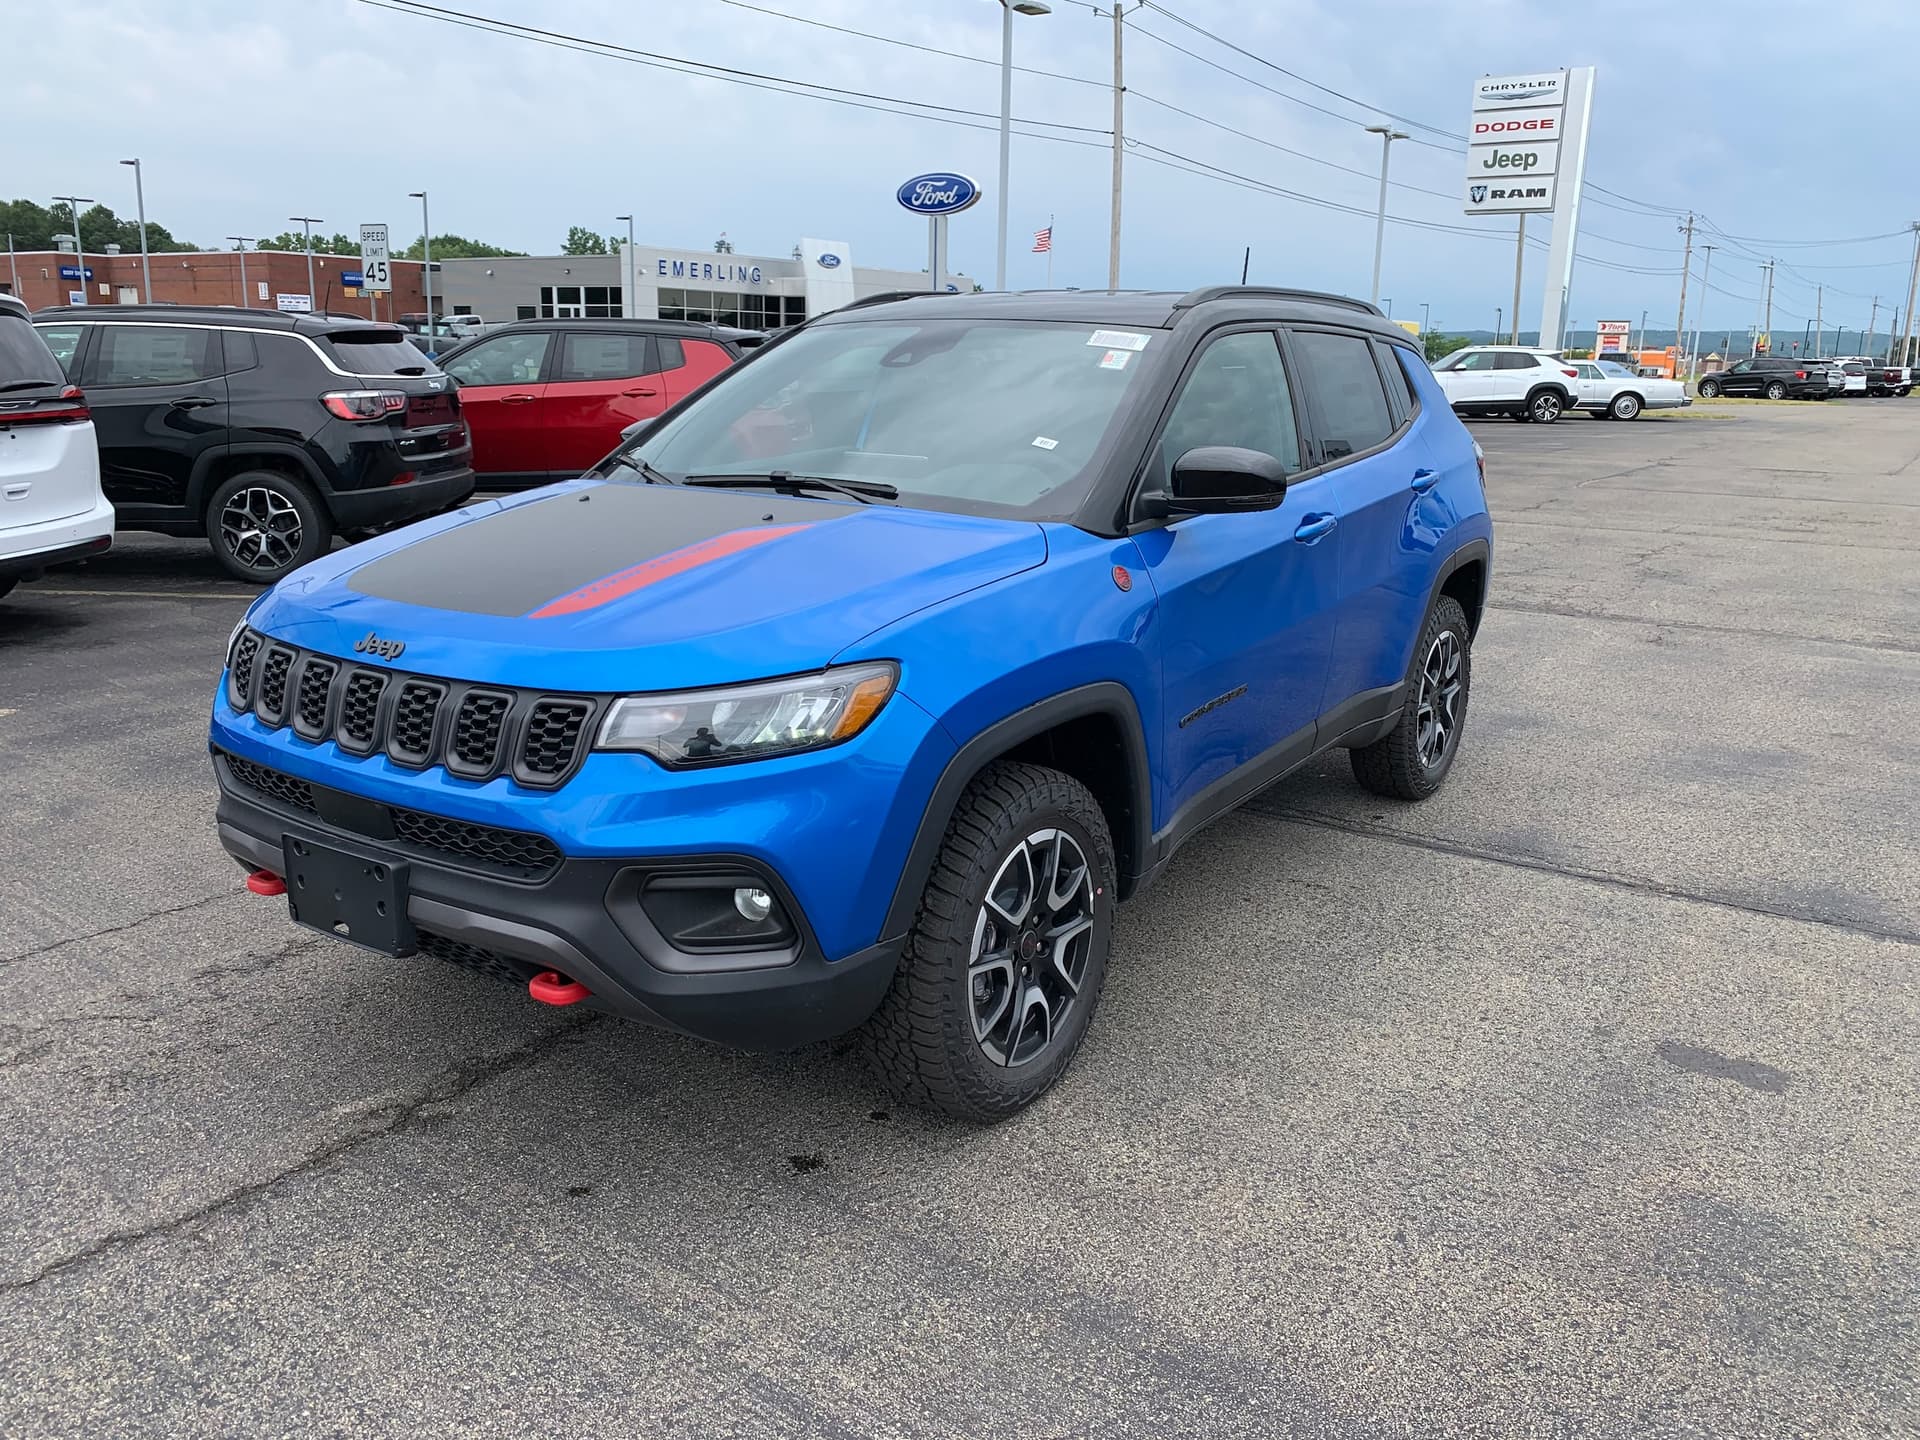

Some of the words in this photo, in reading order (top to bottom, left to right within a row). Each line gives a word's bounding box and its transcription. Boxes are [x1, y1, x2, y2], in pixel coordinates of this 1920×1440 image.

[1481, 80, 1557, 92] CHRYSLER
[1475, 119, 1555, 133] DODGE
[1483, 149, 1538, 171] Jeep
[912, 180, 960, 206] Ford
[1490, 188, 1547, 199] RAM
[362, 231, 386, 242] SPEED
[365, 247, 384, 257] LIMIT
[366, 262, 388, 283] 45
[658, 259, 761, 282] EMERLING
[353, 631, 406, 662] Jeep
